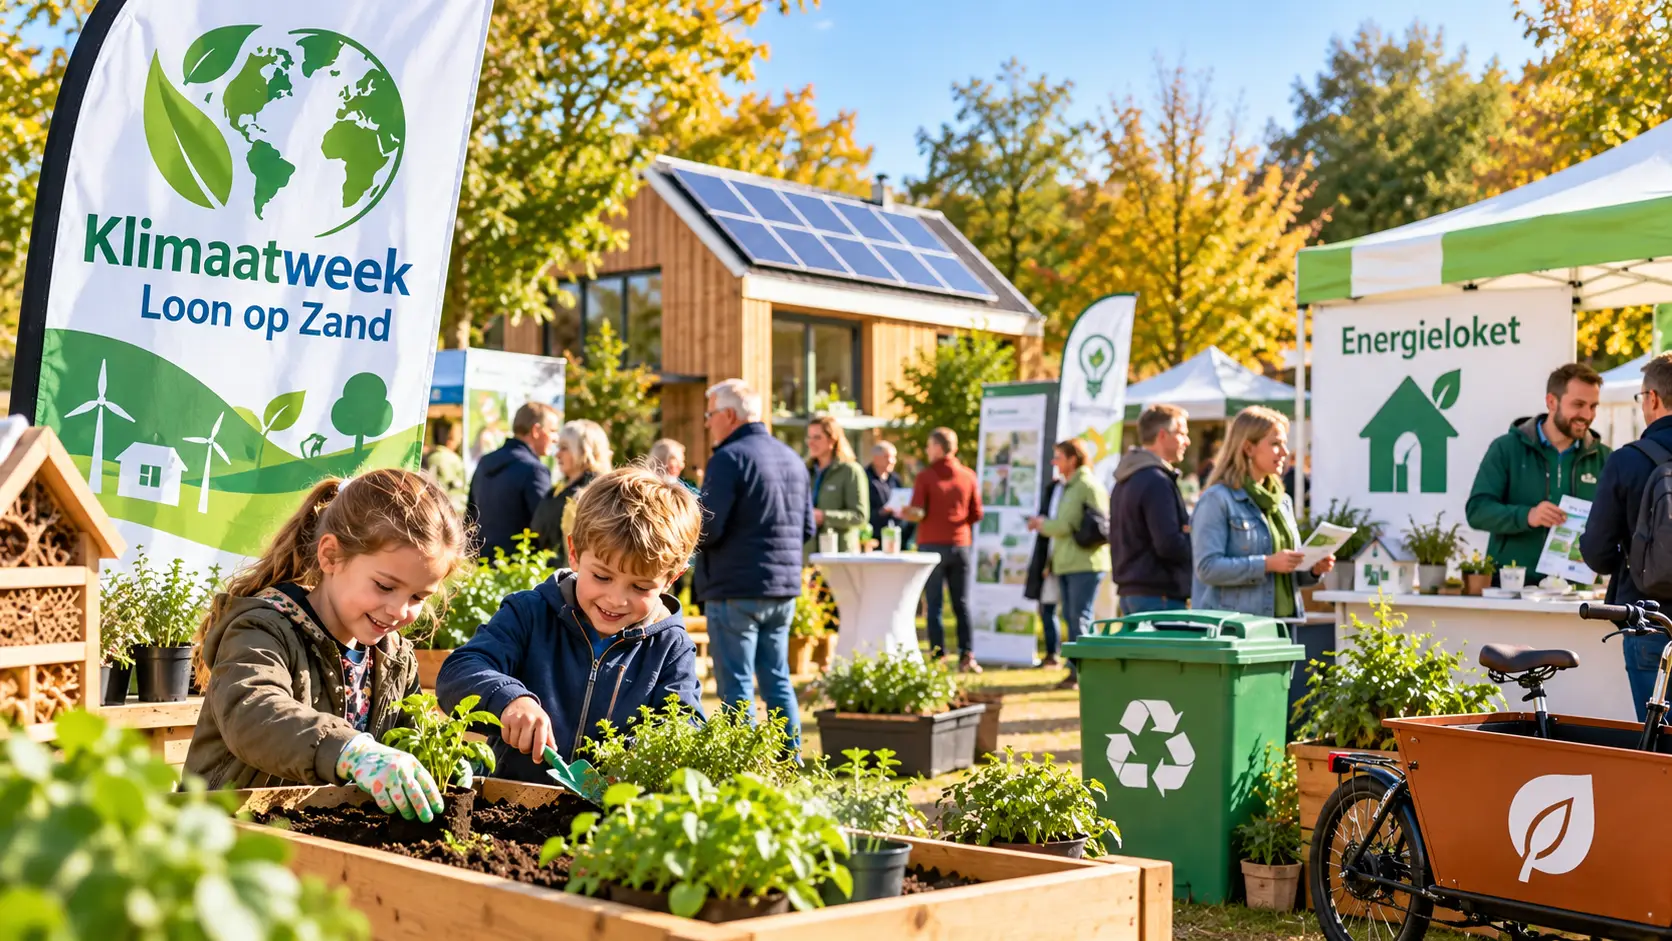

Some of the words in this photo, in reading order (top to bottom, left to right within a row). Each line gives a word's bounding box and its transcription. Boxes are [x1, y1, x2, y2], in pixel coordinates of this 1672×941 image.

[83, 213, 414, 296] Klimaatweek
[141, 284, 232, 327] Loon
[244, 305, 289, 341] op
[299, 301, 392, 342] Zand
[1342, 315, 1521, 360] Energieloket
